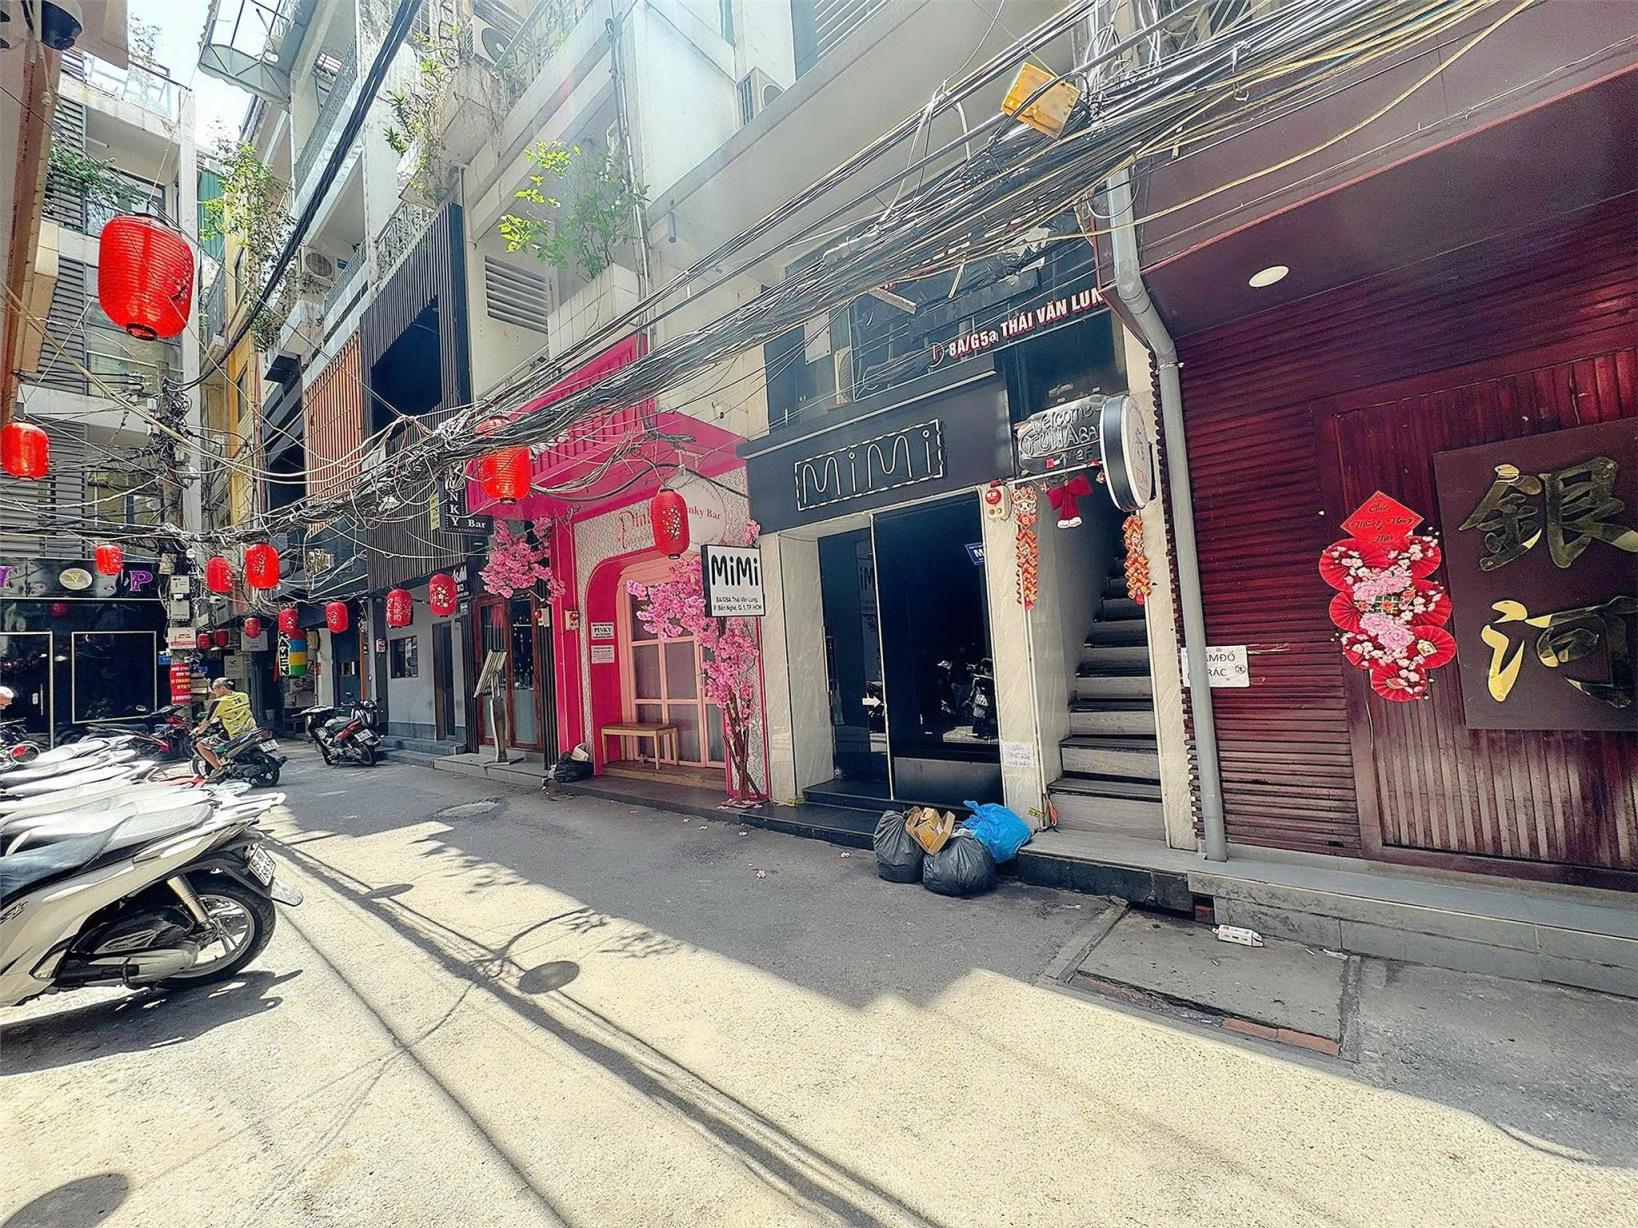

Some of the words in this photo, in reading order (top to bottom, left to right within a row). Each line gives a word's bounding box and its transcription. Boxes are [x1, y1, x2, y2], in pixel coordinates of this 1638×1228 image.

[1000, 312, 1034, 338] THÁI
[1036, 299, 1068, 325] VĂN
[1079, 424, 1101, 444] BA
[688, 506, 704, 520] nky
[706, 508, 721, 520] Bar
[468, 519, 486, 528] Bar
